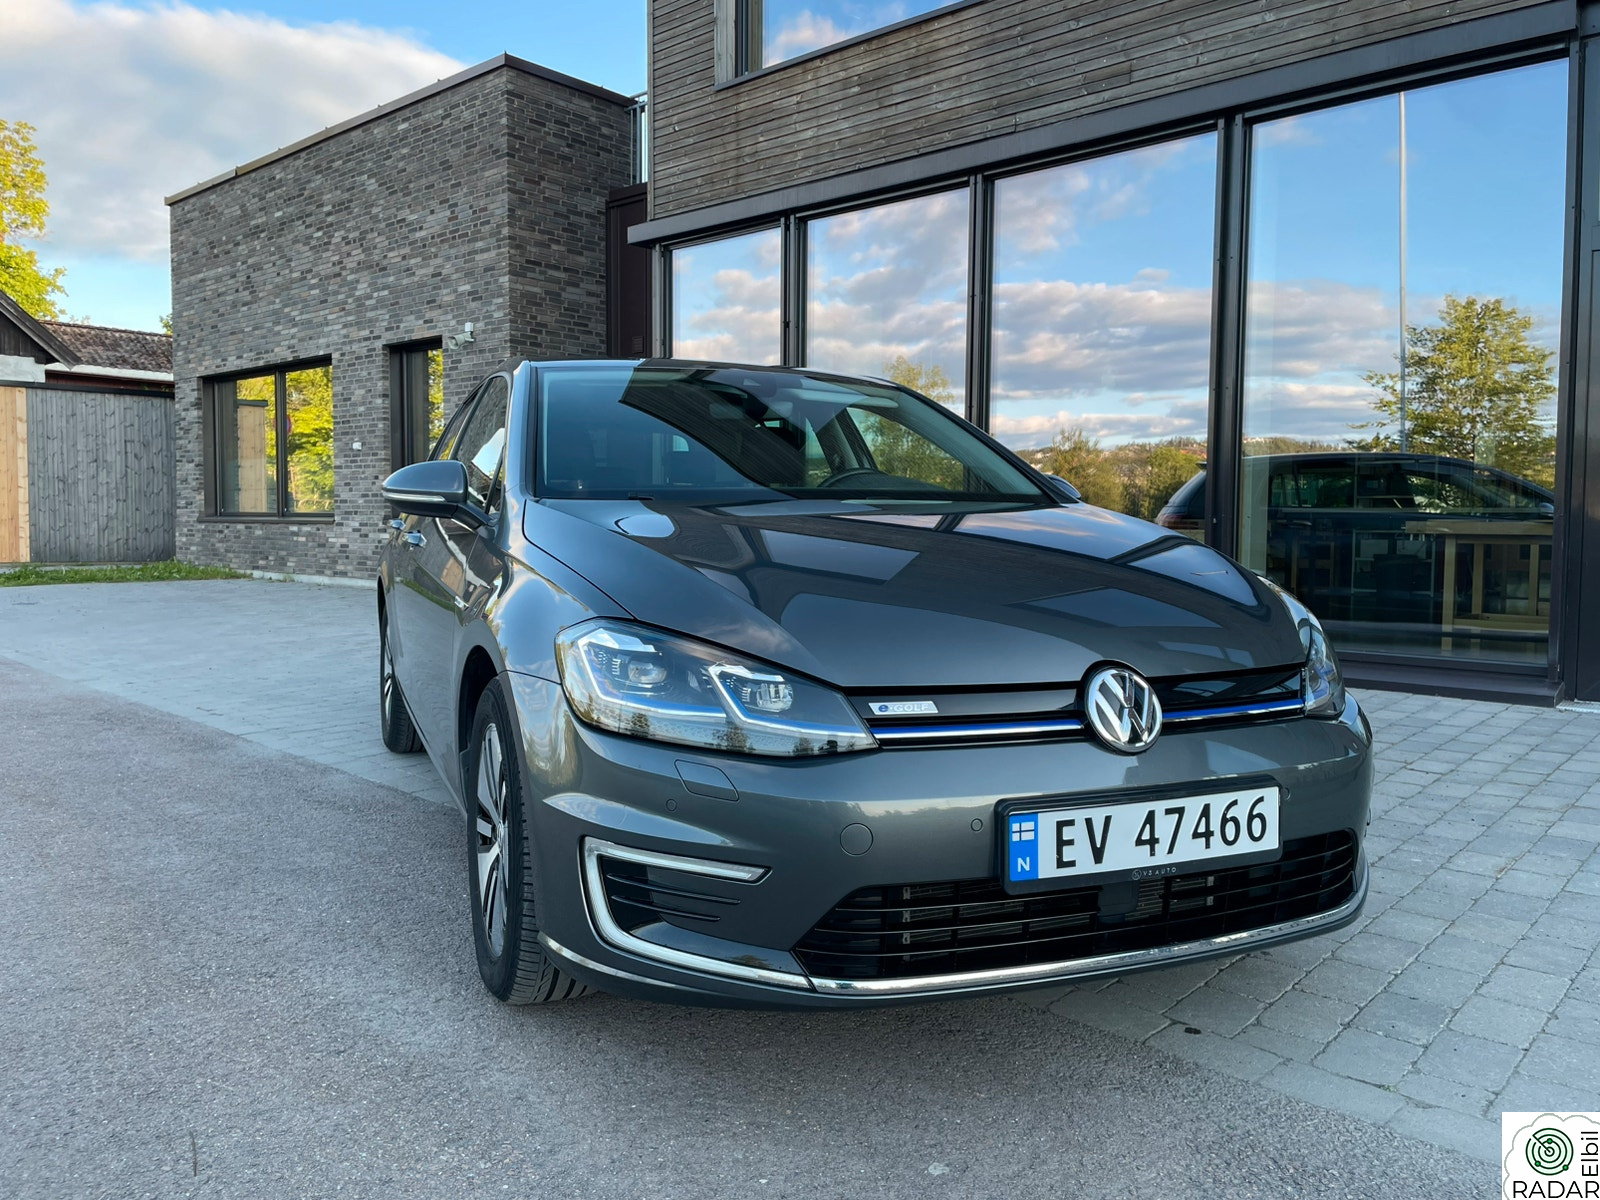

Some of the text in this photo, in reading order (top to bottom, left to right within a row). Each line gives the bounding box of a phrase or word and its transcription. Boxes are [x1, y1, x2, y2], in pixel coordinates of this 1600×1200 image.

[1056, 796, 1267, 869] EV 47466
[1017, 856, 1030, 873] N
[1155, 866, 1177, 875] AUTO
